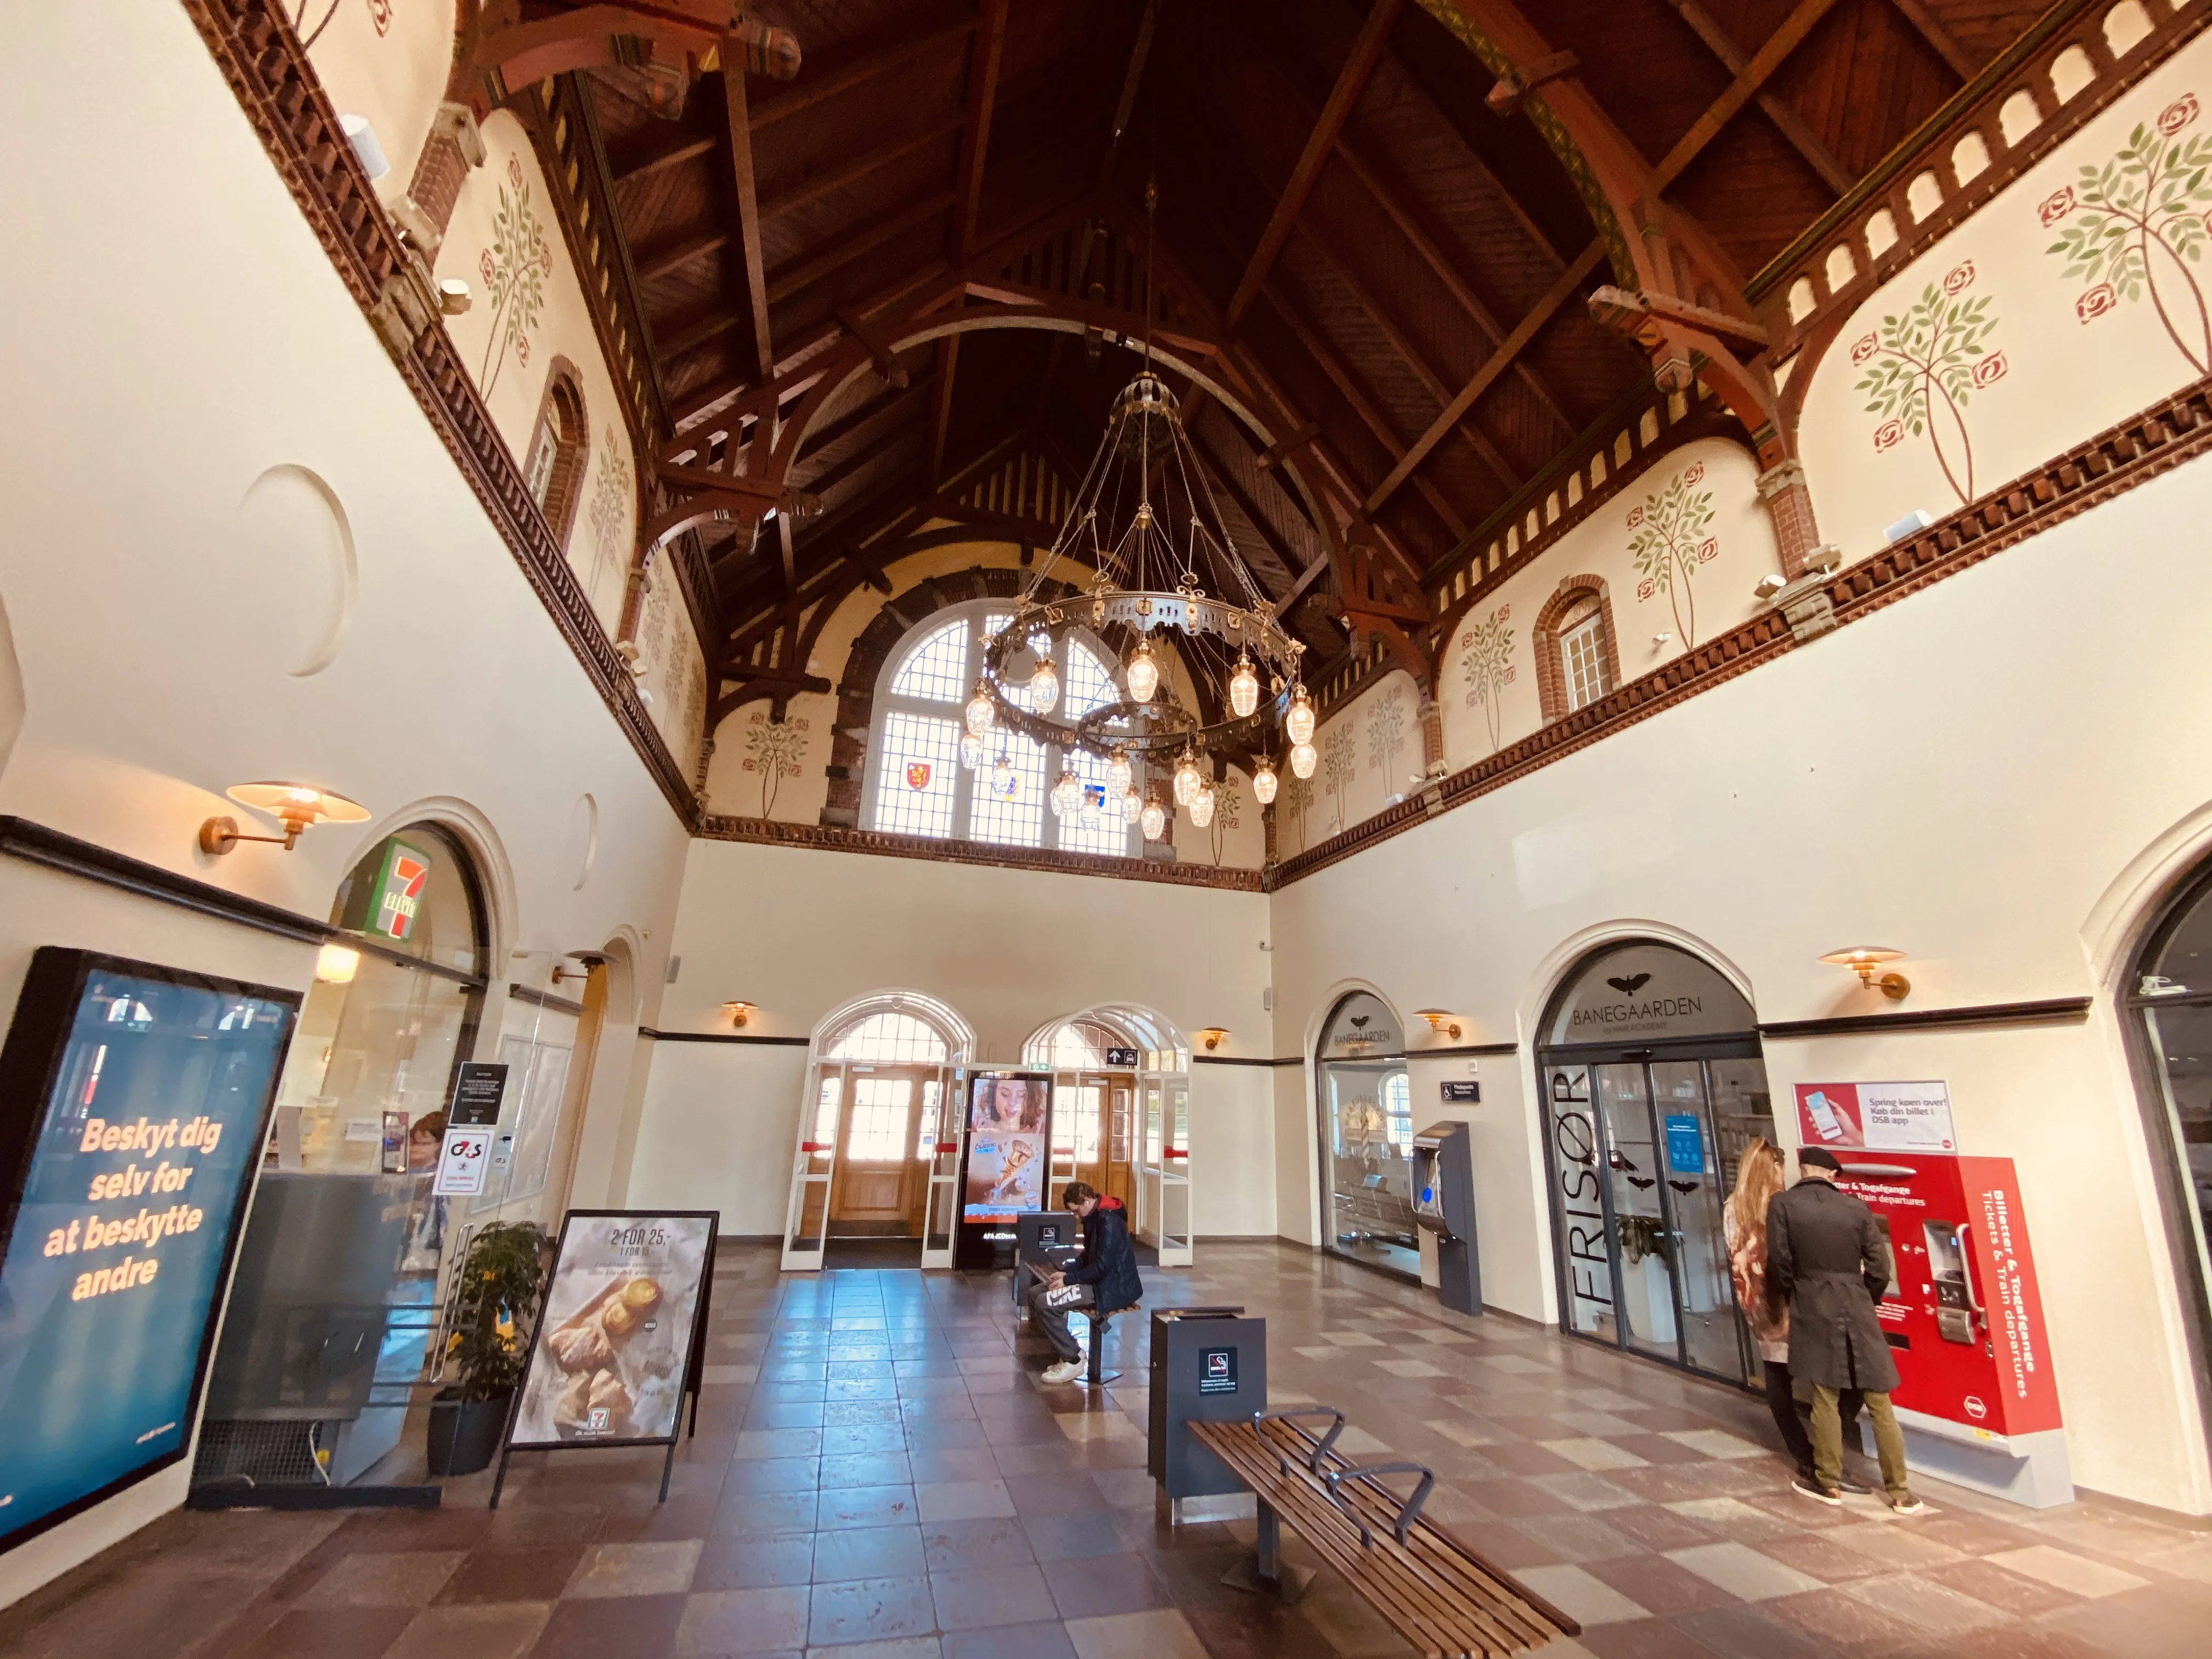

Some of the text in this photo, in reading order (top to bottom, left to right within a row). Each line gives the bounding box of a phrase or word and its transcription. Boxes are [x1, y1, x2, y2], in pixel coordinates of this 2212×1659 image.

[388, 856, 427, 939] 7
[1573, 996, 1702, 1025] BANEGAARDEN
[1631, 1021, 1667, 1031] ACADEMY
[1334, 1030, 1390, 1046] BANEGAARDEN
[1870, 1098, 1897, 1107] Spring
[1906, 1107, 1929, 1115] billet
[1892, 1118, 1909, 1126] app
[80, 1116, 223, 1158] Beskyt dig
[88, 1161, 194, 1201] selv for
[1553, 1072, 1612, 1305] FRISØR
[1859, 1182, 1911, 1195] Togafgange
[1856, 1192, 1926, 1206] Train departures
[44, 1204, 204, 1257] at beskytte
[611, 1229, 620, 1245] 2
[622, 1229, 646, 1245] FOR
[625, 1247, 640, 1256] FOR
[71, 1256, 159, 1301] andre
[1994, 1190, 2034, 1373] Billetter & Togafgange
[1046, 1284, 1082, 1307] NIKE
[1982, 1190, 2027, 1399] Tickets & Train departures
